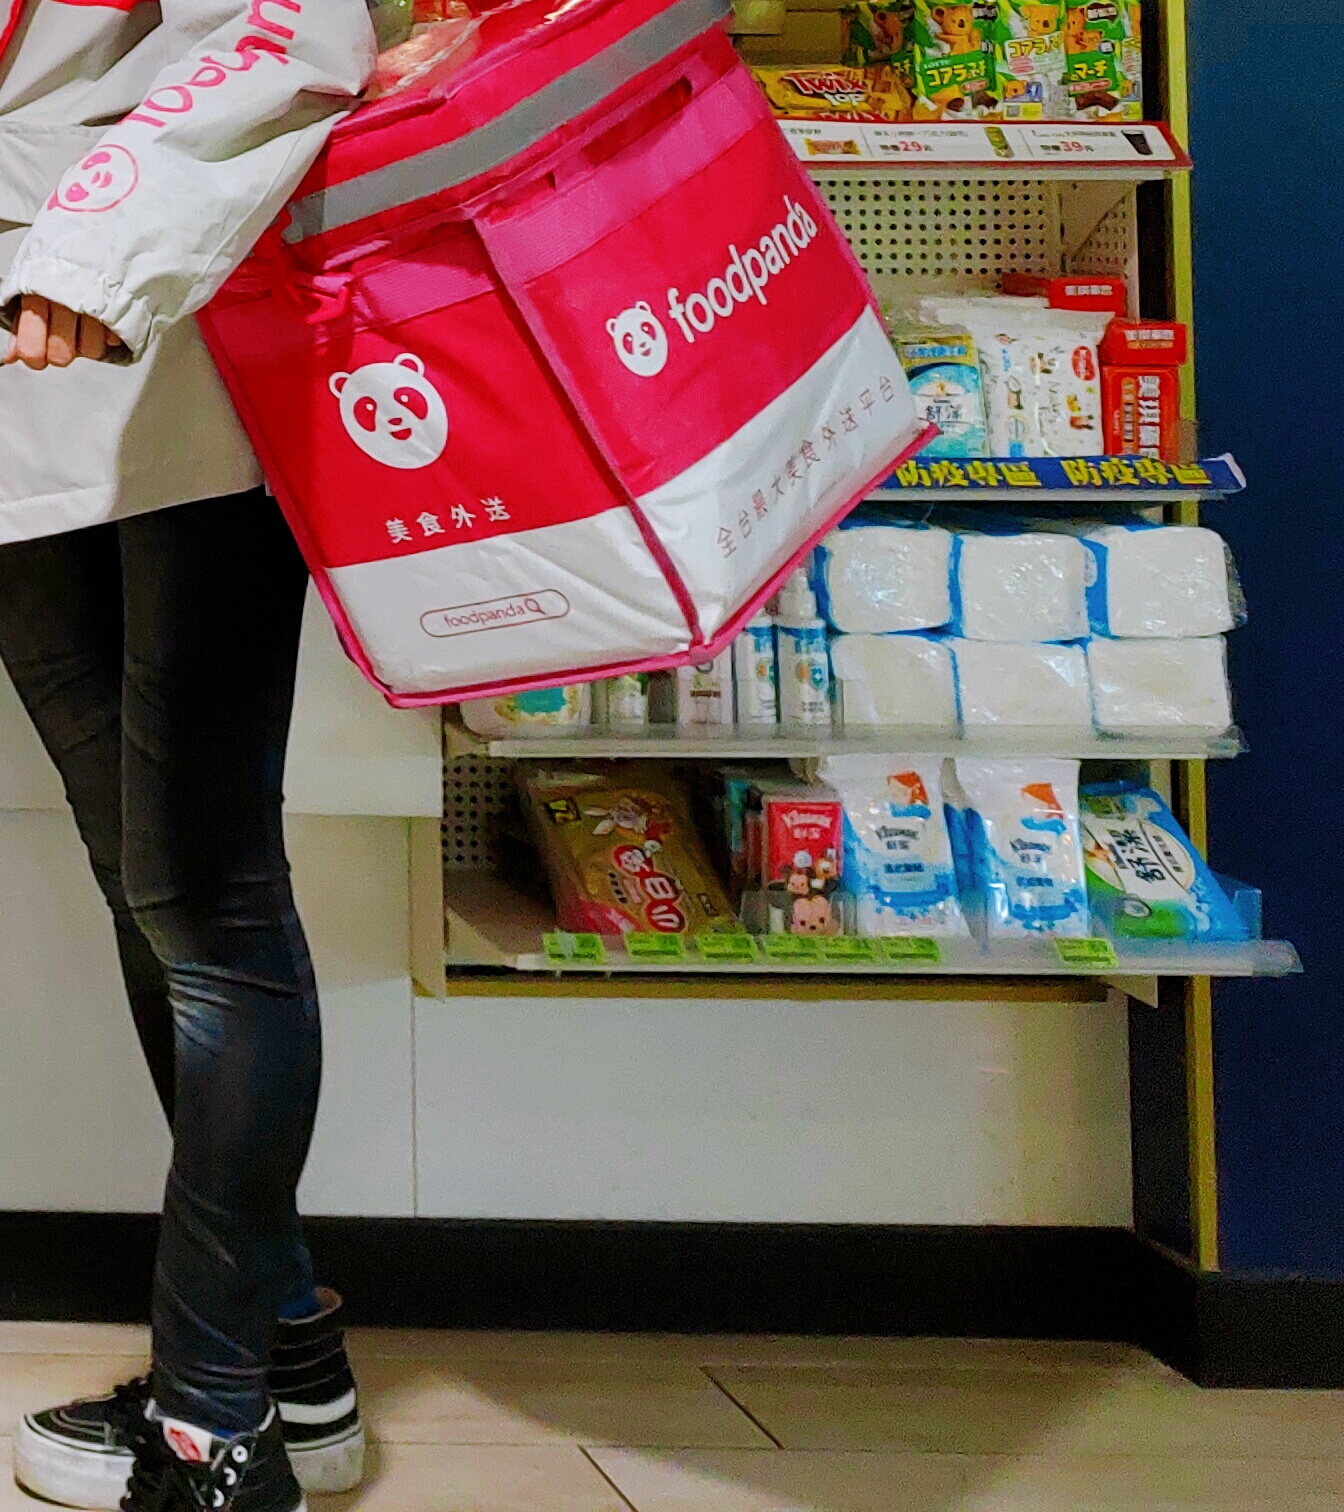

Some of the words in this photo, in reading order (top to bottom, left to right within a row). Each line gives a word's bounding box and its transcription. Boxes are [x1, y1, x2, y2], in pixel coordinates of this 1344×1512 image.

[667, 195, 819, 345] foodpanda
[385, 496, 513, 545] 美食外送
[444, 602, 526, 629] foodpanda
